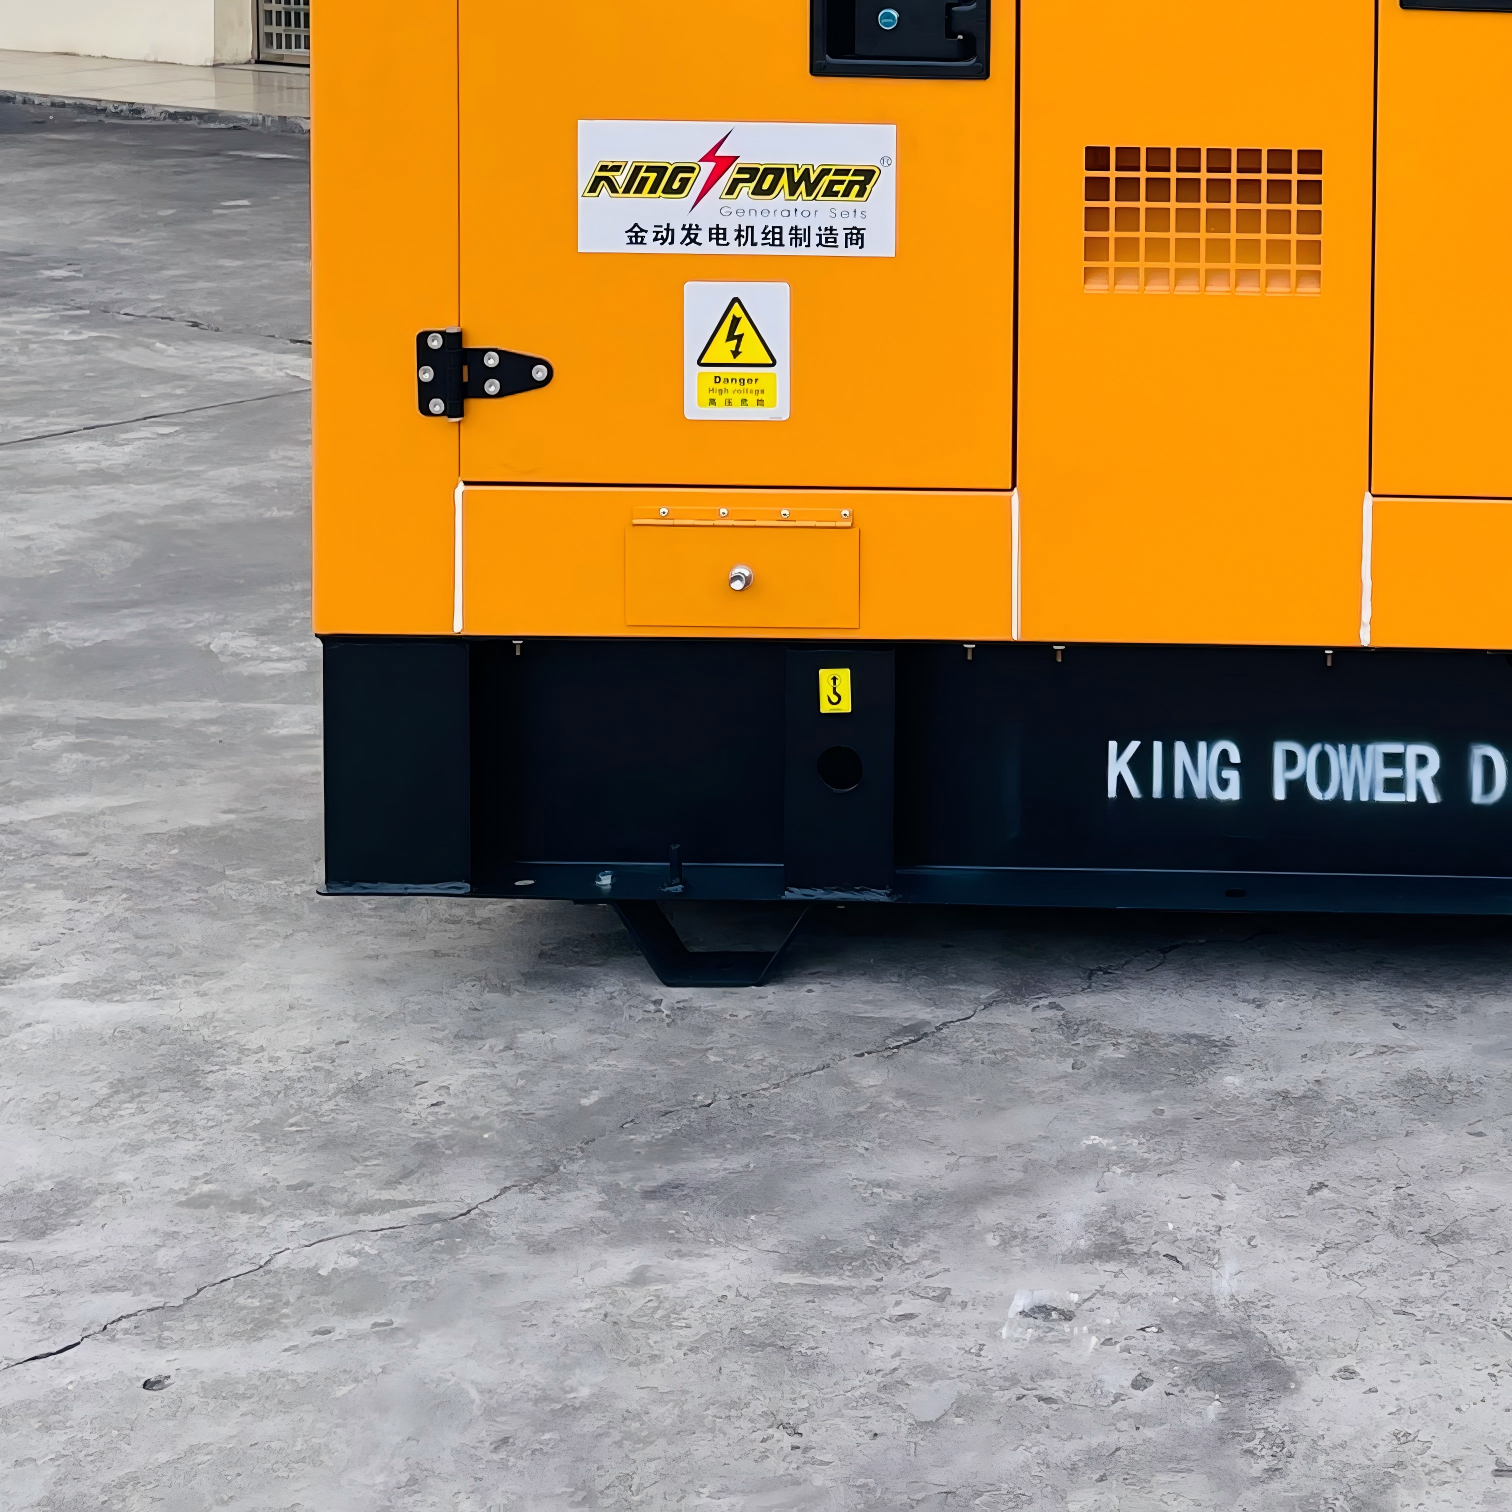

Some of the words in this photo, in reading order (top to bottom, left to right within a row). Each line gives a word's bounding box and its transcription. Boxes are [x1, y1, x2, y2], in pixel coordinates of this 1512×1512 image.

[582, 160, 701, 199] KING
[719, 162, 881, 202] POWER
[719, 205, 819, 219] Generator
[829, 207, 867, 220] Sets
[624, 222, 867, 250] 金动发电机组制造商
[1107, 739, 1242, 803] KING
[1272, 740, 1442, 805] POWER
